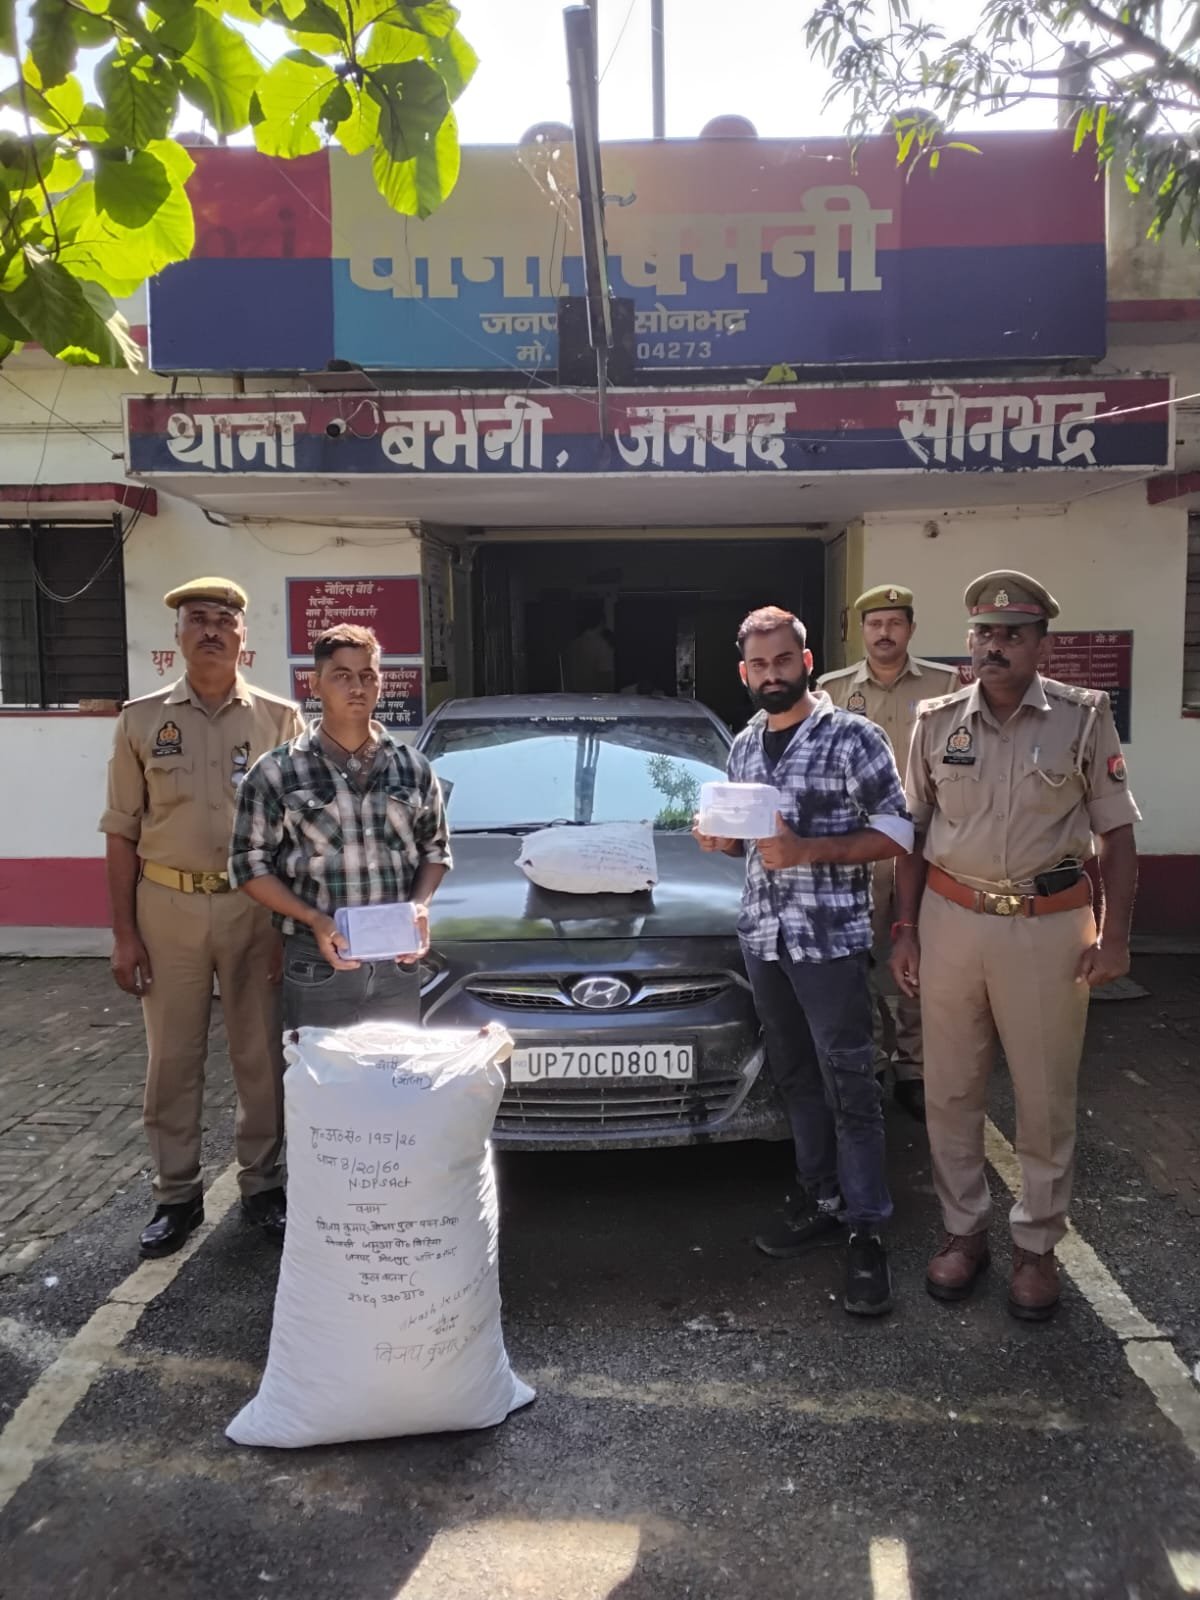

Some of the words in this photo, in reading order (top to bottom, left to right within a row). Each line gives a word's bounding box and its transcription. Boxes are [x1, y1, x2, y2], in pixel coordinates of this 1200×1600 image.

[637, 342, 712, 360] 04273
[166, 410, 306, 470] थाना
[614, 400, 797, 470] जनपद
[896, 385, 1106, 466] सोनभद्र
[528, 1050, 689, 1077] UP70CD8010
